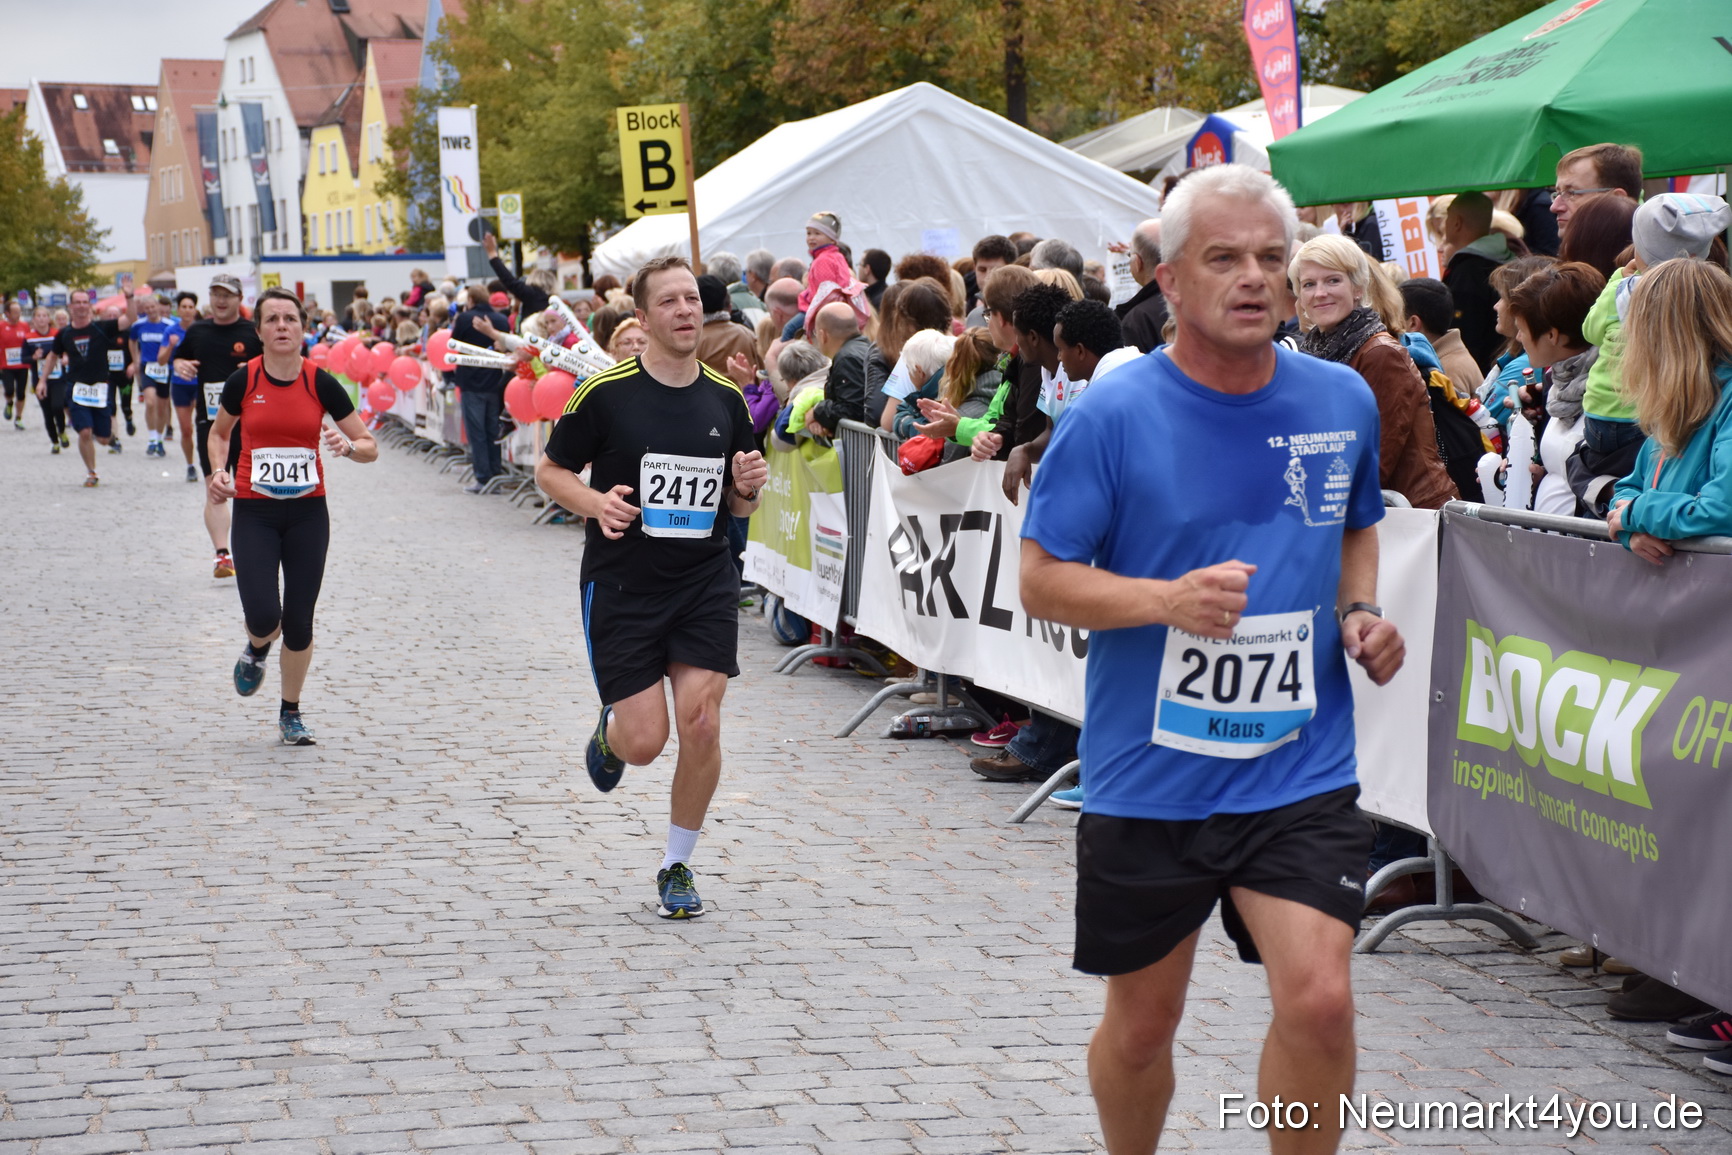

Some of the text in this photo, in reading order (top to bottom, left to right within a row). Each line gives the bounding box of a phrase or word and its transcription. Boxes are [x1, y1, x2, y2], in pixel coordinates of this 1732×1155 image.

[627, 109, 682, 131] Block
[639, 139, 676, 192] B
[1267, 431, 1357, 448] 12. NEUMARKTER
[1289, 442, 1346, 456] STADTLAUF
[259, 462, 311, 483] 2041
[643, 461, 714, 474] PARTL Neumarkt
[648, 474, 718, 507] 2412
[668, 513, 690, 526] Toni
[1226, 630, 1292, 645] Neumarkt
[1176, 648, 1302, 704] 2074
[1465, 636, 1662, 786] BOCK
[1208, 717, 1265, 738] Klaus
[1453, 749, 1525, 803] inspired
[1538, 790, 1578, 832] smart
[1581, 808, 1660, 863] concepts
